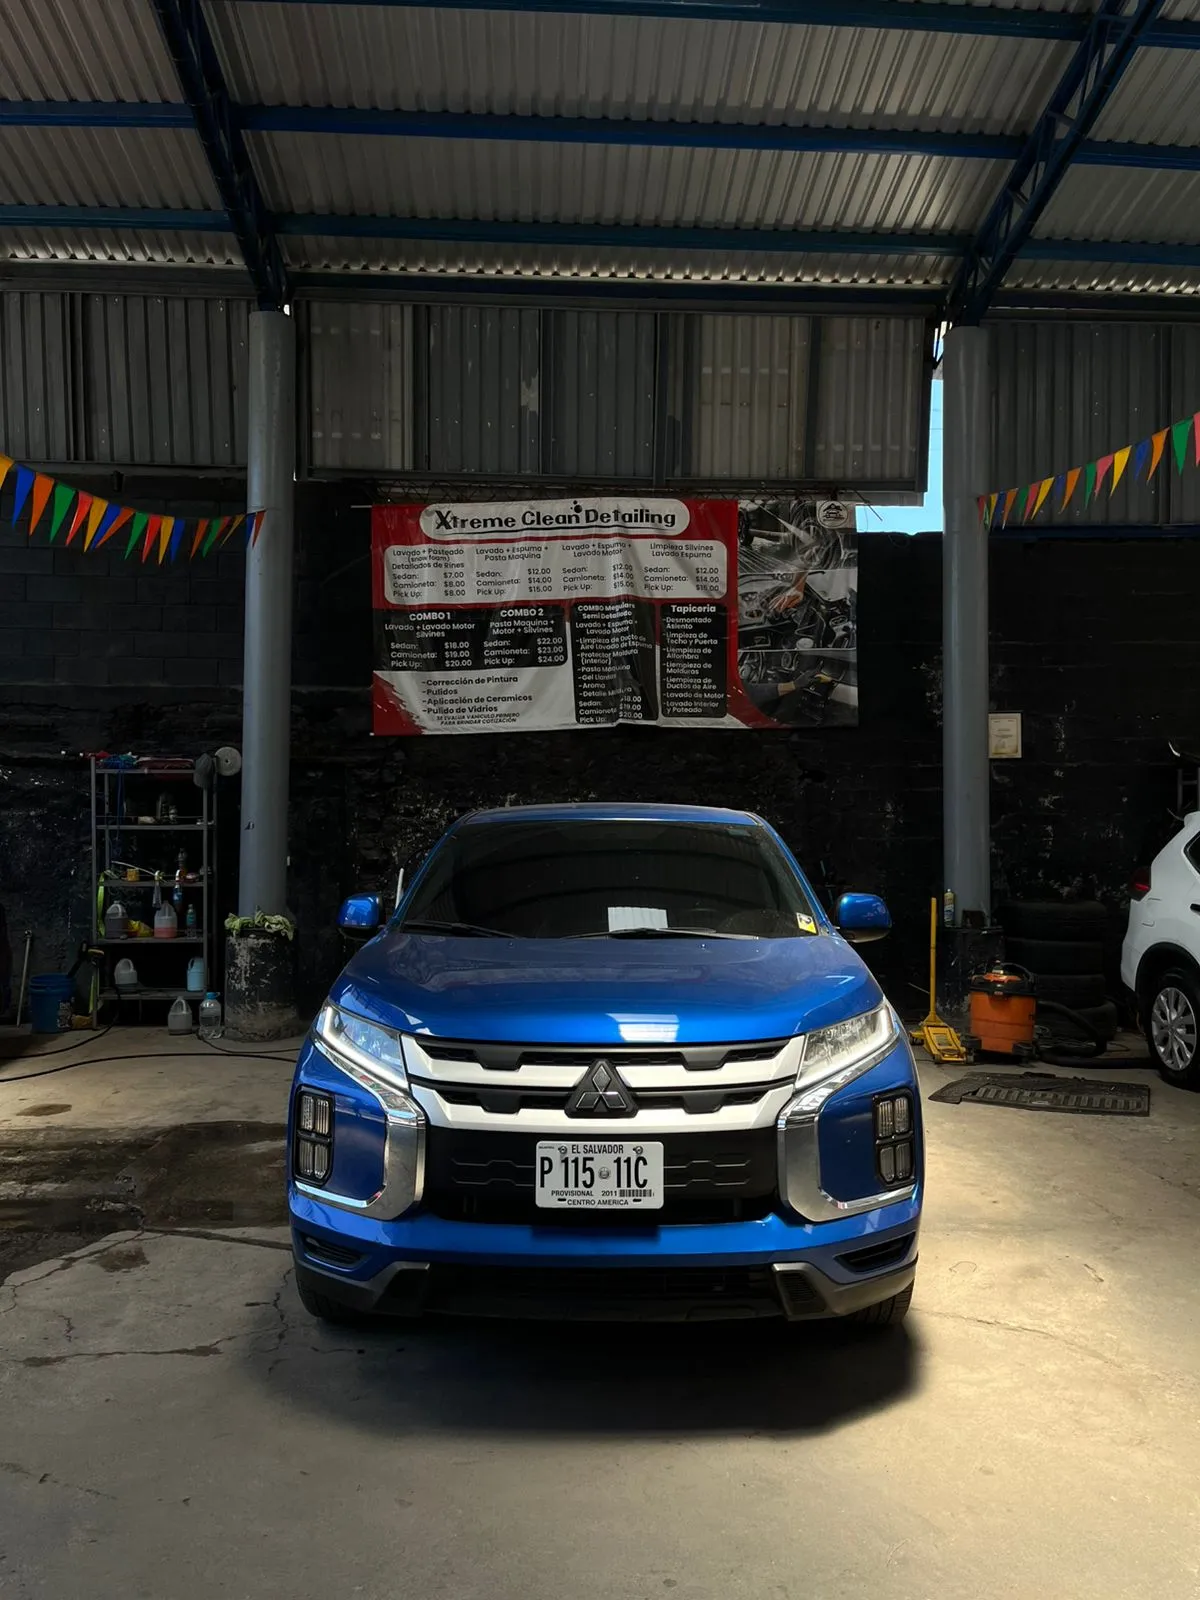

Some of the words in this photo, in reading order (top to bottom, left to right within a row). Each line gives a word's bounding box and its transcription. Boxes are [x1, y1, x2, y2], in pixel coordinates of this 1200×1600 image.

[435, 510, 516, 530] Xtreme
[521, 510, 580, 526] Clean
[585, 508, 676, 528] Detailing
[475, 547, 504, 555] Lavado
[512, 546, 542, 555] Espuma
[597, 542, 626, 551] Espuma
[650, 543, 684, 552] Limpieza
[685, 543, 714, 551] Silvines
[393, 548, 420, 556] Lavado
[602, 549, 624, 557] Motor
[681, 552, 712, 560] Espuma
[484, 554, 507, 562] Pasta
[508, 552, 541, 561] Maquina
[612, 564, 633, 572] $12.00
[443, 571, 464, 579] $7.00
[476, 570, 503, 578] Sedan:
[562, 574, 607, 583] Camioneta:
[612, 572, 634, 580] $14.00
[393, 580, 437, 589] Camioneta:
[444, 580, 466, 588] $8.00
[476, 578, 521, 587] Camioneta:
[528, 576, 552, 584] $14.00
[476, 588, 493, 596] Pick
[494, 588, 506, 597] Up:
[528, 585, 553, 593] $15.00
[563, 584, 579, 592] Pick
[580, 584, 593, 592] Up:
[613, 581, 635, 589] $15.00
[663, 584, 674, 592] Up:
[411, 591, 423, 599] Up:
[444, 589, 466, 597] $8.00
[577, 604, 604, 612] COMBO
[670, 604, 716, 615] Tapiceria
[409, 613, 446, 621] COMBO
[500, 609, 535, 618] COMBO
[537, 609, 544, 617] 2
[385, 623, 414, 631] Lavado
[421, 623, 451, 631] Lavado
[452, 622, 475, 630] Motor
[489, 621, 512, 629] Pasta
[513, 619, 548, 628] Maquina
[576, 621, 602, 629] Lavado
[416, 630, 446, 639] Silvines
[491, 627, 514, 636] Motor
[523, 626, 553, 634] Silvines
[390, 642, 418, 650] Sedan:
[444, 641, 469, 649] $18.00
[483, 640, 511, 648] Sedan:
[537, 637, 563, 645] $22.00
[595, 642, 620, 650] Lavado
[390, 650, 438, 659] Camioneta:
[444, 650, 470, 658] $19.00
[483, 647, 531, 656] Camioneta:
[537, 646, 564, 654] $23.00
[391, 660, 408, 668] Pick
[409, 660, 423, 669] Up:
[445, 659, 472, 667] $20.00
[484, 657, 501, 666] Pick
[501, 657, 515, 666] Up:
[537, 655, 565, 663] $24.00
[702, 662, 713, 670] de
[487, 675, 519, 684] Pintura
[474, 696, 485, 704] de
[486, 694, 533, 703] Ceramicos
[455, 706, 467, 714] de
[467, 704, 499, 713] Vidrios
[571, 1144, 582, 1154] EL
[582, 1144, 625, 1155] SALVADOR
[540, 1156, 554, 1189] P
[560, 1156, 595, 1190] 115
[613, 1156, 649, 1190] 11C
[551, 1190, 594, 1198] PROVISIONAL
[567, 1198, 596, 1206] CENTRO
[597, 1198, 629, 1206] AMERICA
